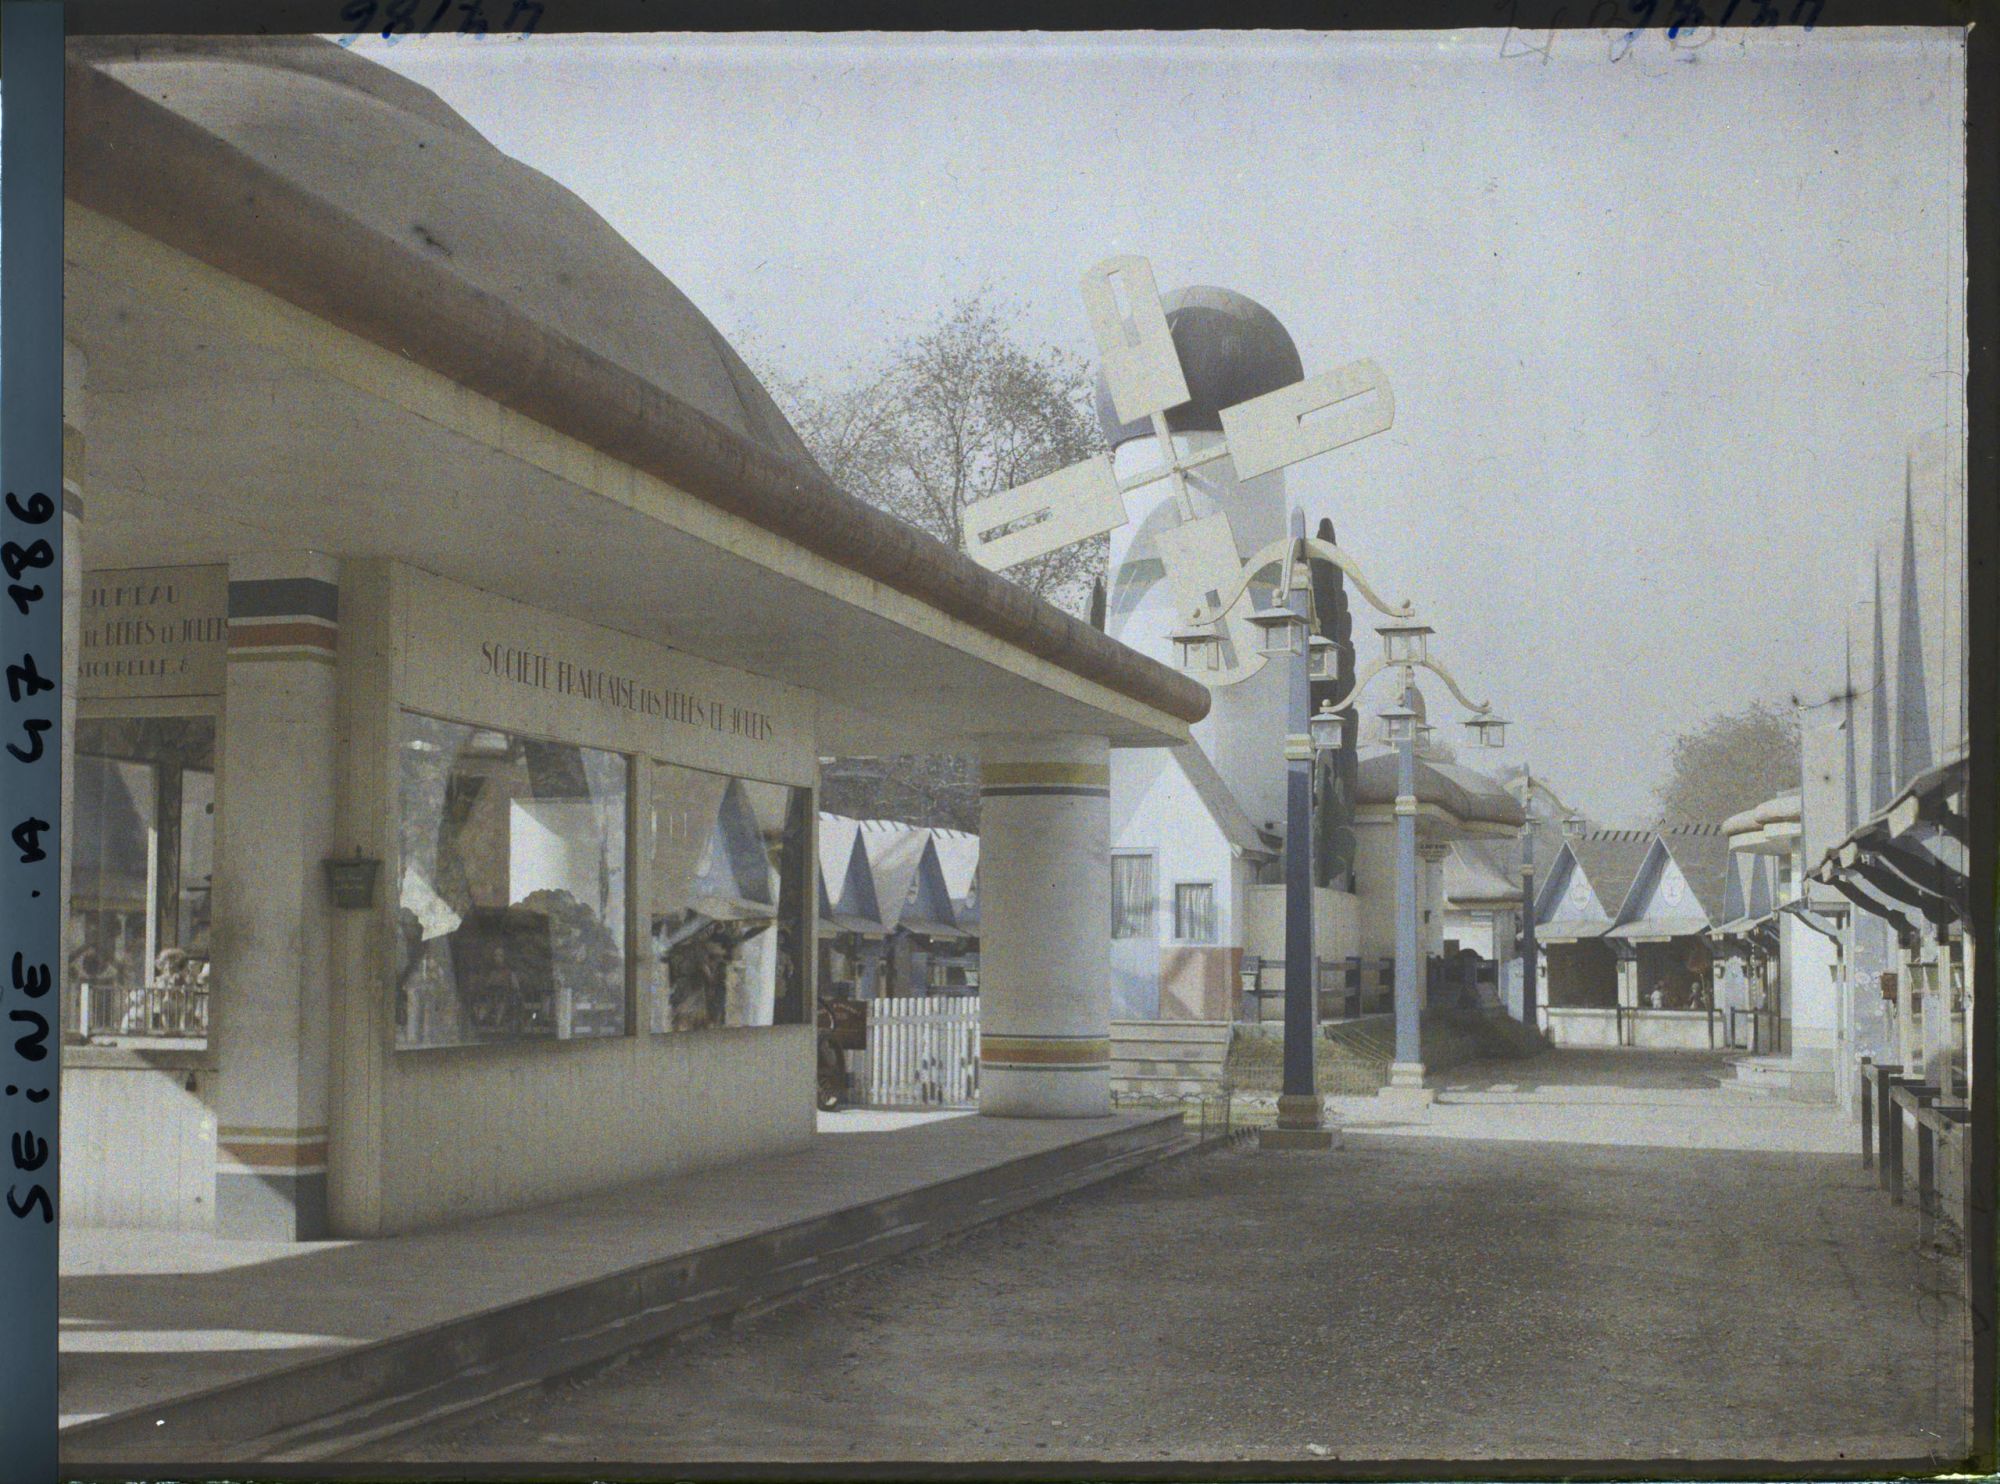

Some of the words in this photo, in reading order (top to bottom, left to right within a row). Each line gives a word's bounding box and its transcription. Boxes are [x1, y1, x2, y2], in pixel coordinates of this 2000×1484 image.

[82, 585, 181, 608] JUMEAU
[557, 660, 637, 712] FRANÇAISE
[710, 701, 723, 732] ET
[729, 707, 773, 742] JOUETS
[11, 816, 50, 864] A
